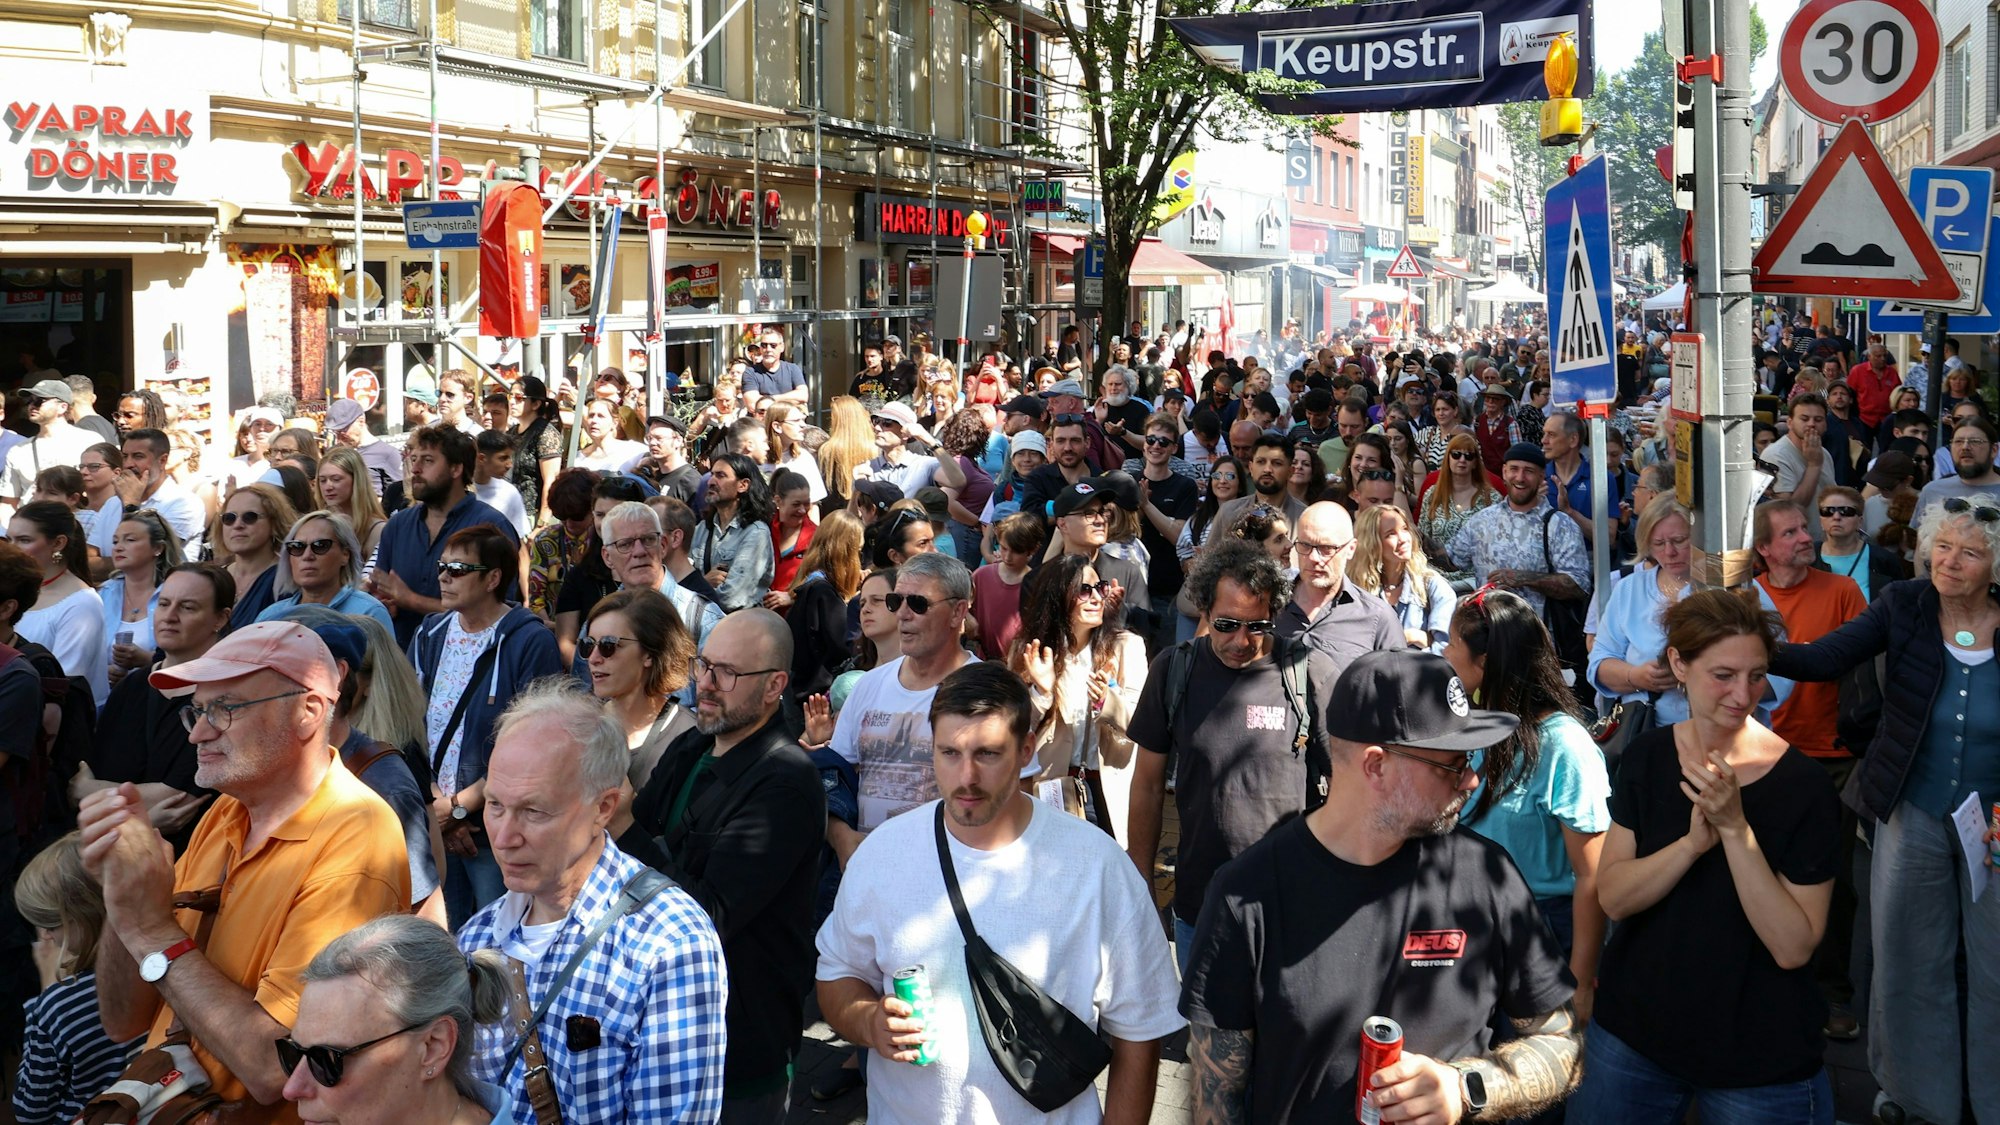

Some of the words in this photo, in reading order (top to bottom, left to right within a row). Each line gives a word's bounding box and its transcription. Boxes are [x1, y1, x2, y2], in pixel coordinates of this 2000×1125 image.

[1274, 28, 1465, 81] Keupstr.
[1525, 33, 1536, 41] IG
[1813, 21, 1903, 85] 30
[8, 101, 193, 138] YAPRAK
[30, 140, 179, 184] DÖNER
[288, 139, 553, 206] YAPR
[1025, 183, 1061, 199] KIOSK
[1925, 179, 1970, 236] P
[881, 203, 948, 236] HARRAN
[1407, 933, 1461, 951] DEUS
[1410, 959, 1455, 967] CUSTOMS
